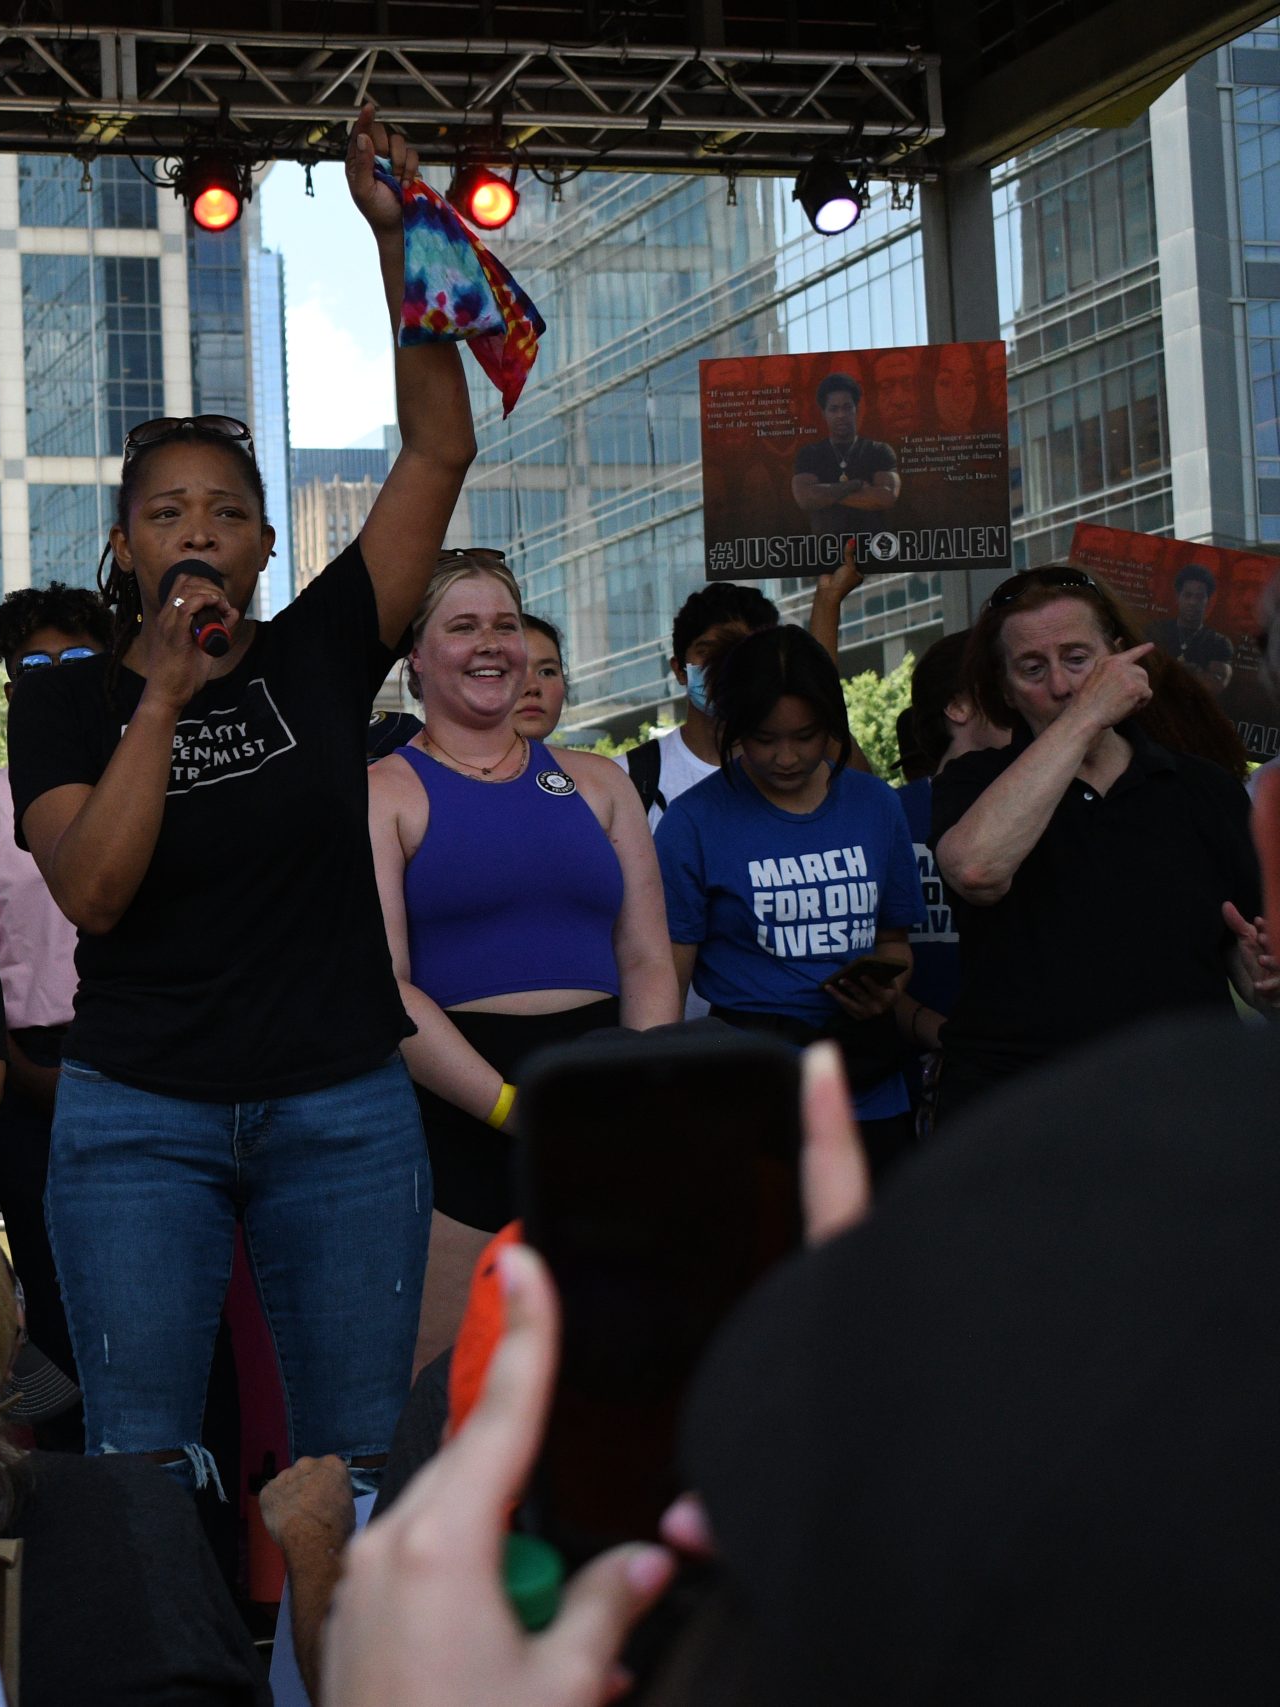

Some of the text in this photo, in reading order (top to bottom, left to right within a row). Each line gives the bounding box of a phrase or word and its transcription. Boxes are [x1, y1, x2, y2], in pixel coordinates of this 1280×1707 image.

[748, 845, 868, 888] MARCH
[753, 881, 878, 922] FOR OUR
[756, 920, 848, 958] LIVES
